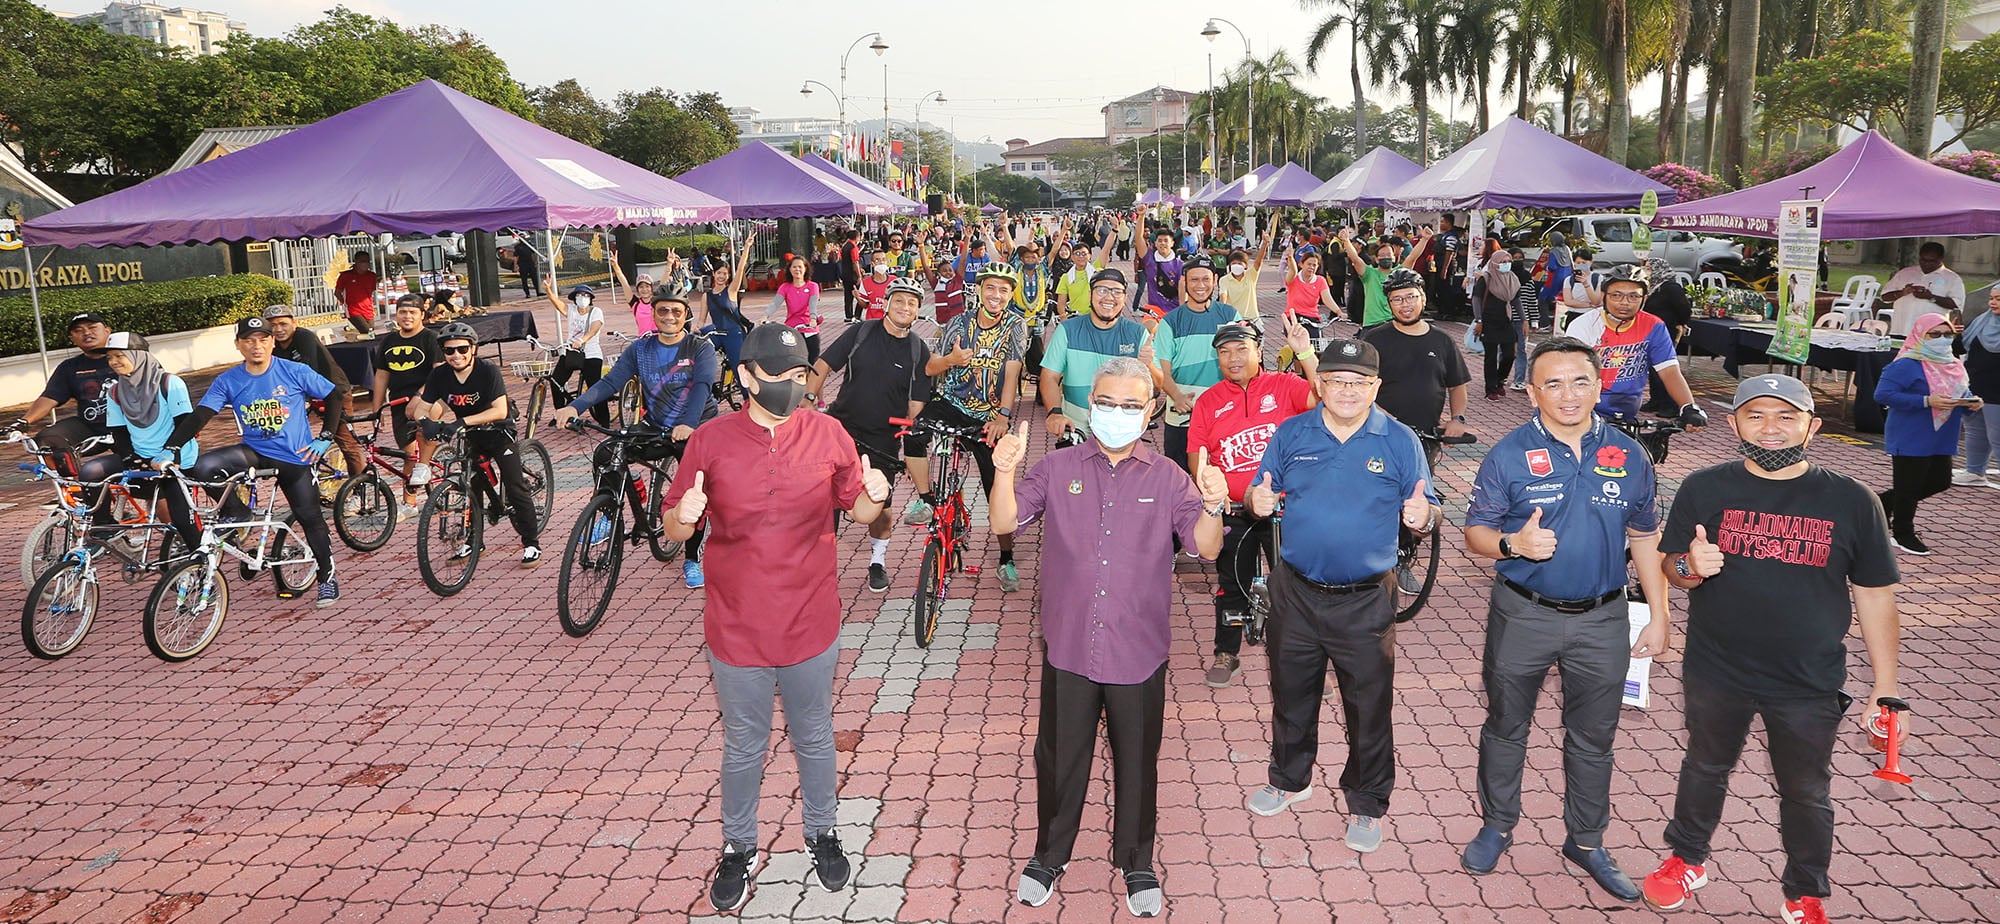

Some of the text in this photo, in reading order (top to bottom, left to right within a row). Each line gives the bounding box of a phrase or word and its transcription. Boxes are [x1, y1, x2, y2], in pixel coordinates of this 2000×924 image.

[1672, 214, 1769, 232] MAJLIS BANDARAYA IPOH
[97, 261, 144, 283] IPOH
[247, 401, 281, 413] KPMSI
[250, 416, 283, 428] 2016
[1720, 509, 1834, 544] BILLIONAIRE
[1718, 529, 1831, 567] BOYS CLUB
